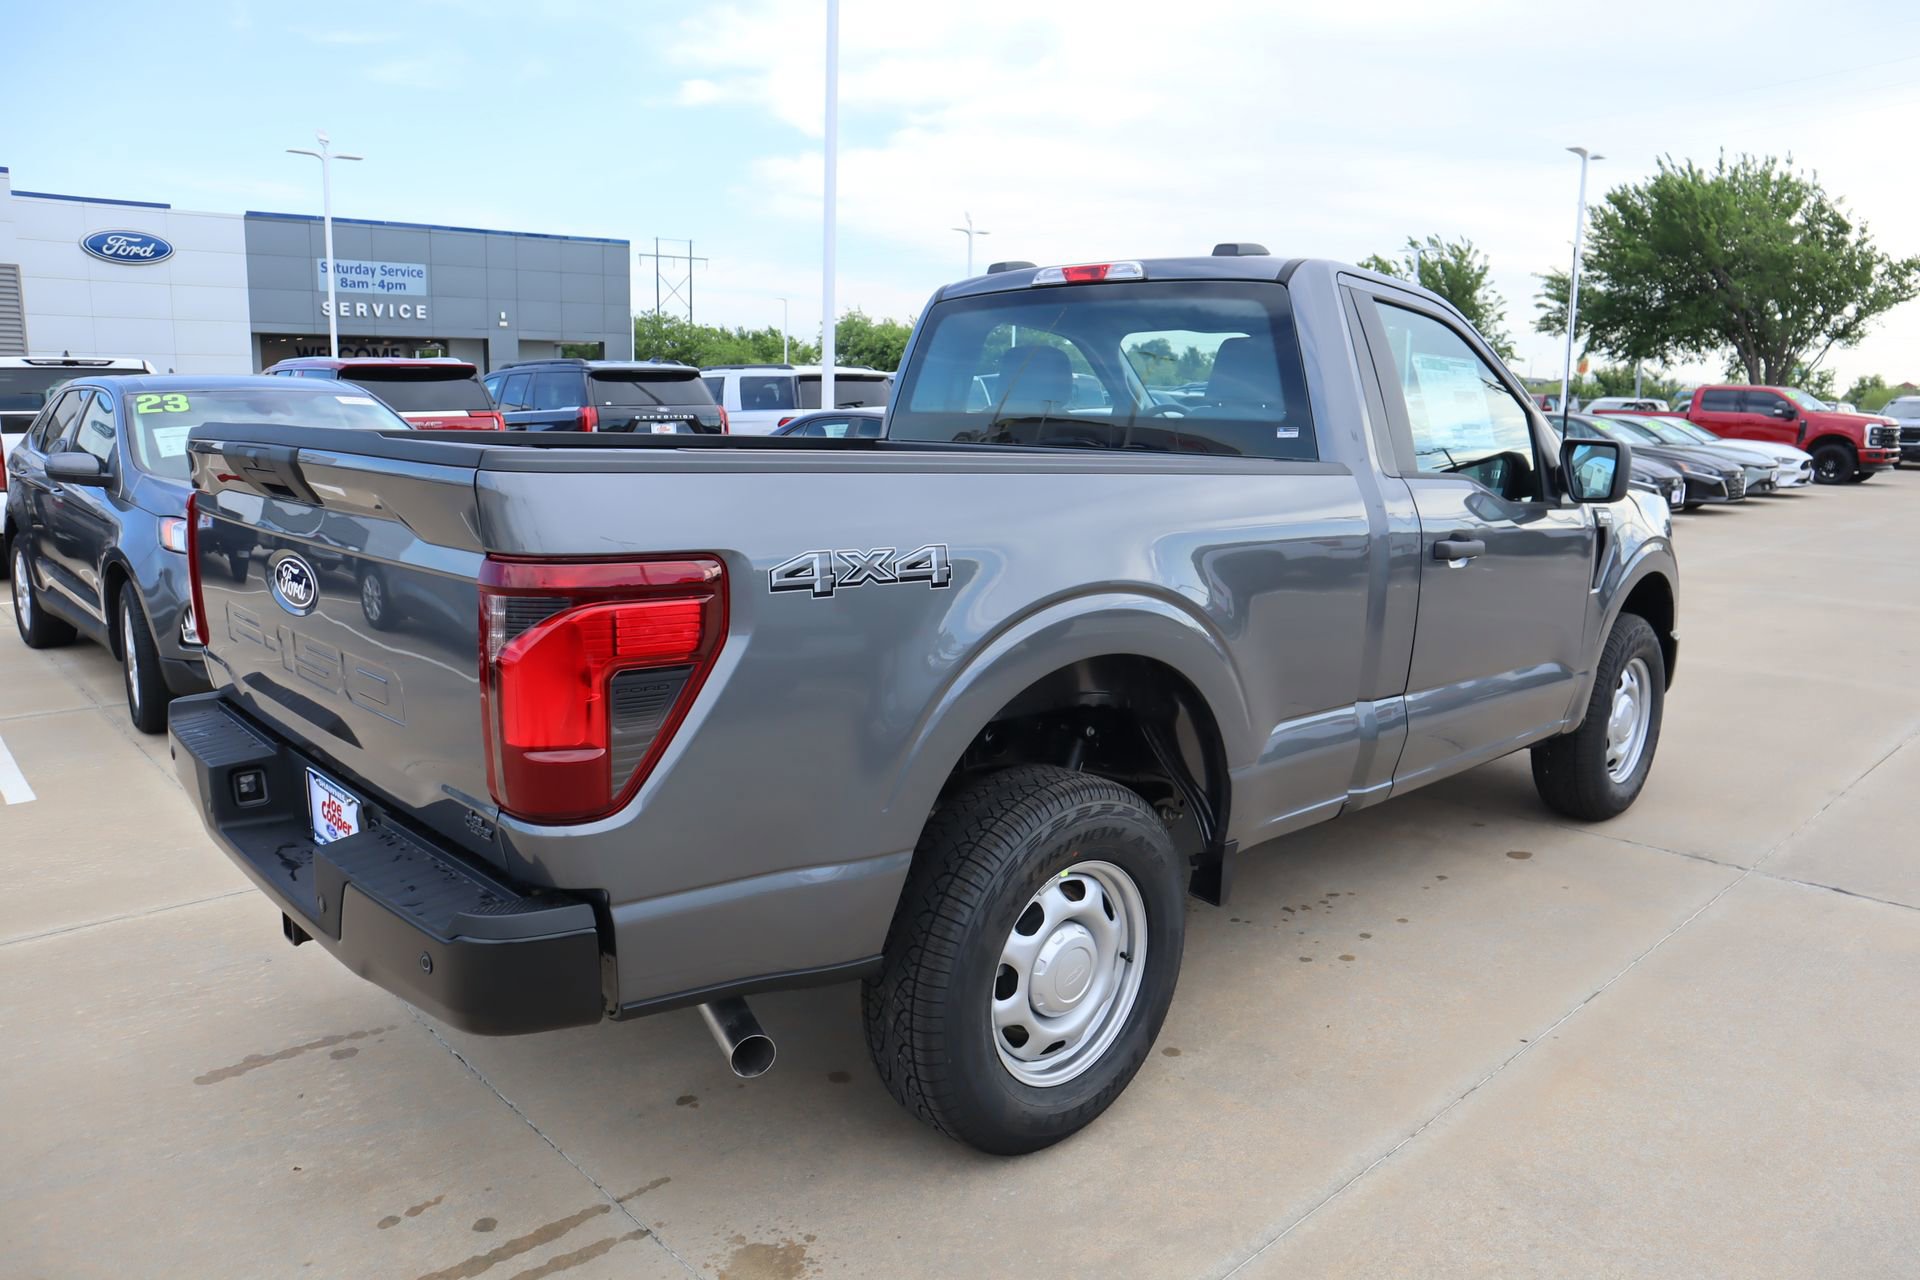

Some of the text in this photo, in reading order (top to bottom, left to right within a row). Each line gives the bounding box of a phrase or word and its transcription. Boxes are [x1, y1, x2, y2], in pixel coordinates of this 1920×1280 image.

[102, 235, 155, 257] Ford
[379, 264, 424, 278] Service
[321, 301, 427, 319] SERVICE
[135, 393, 191, 414] 23
[281, 563, 306, 601] Ford
[326, 792, 343, 818] Joe
[321, 800, 353, 836] Cooper
